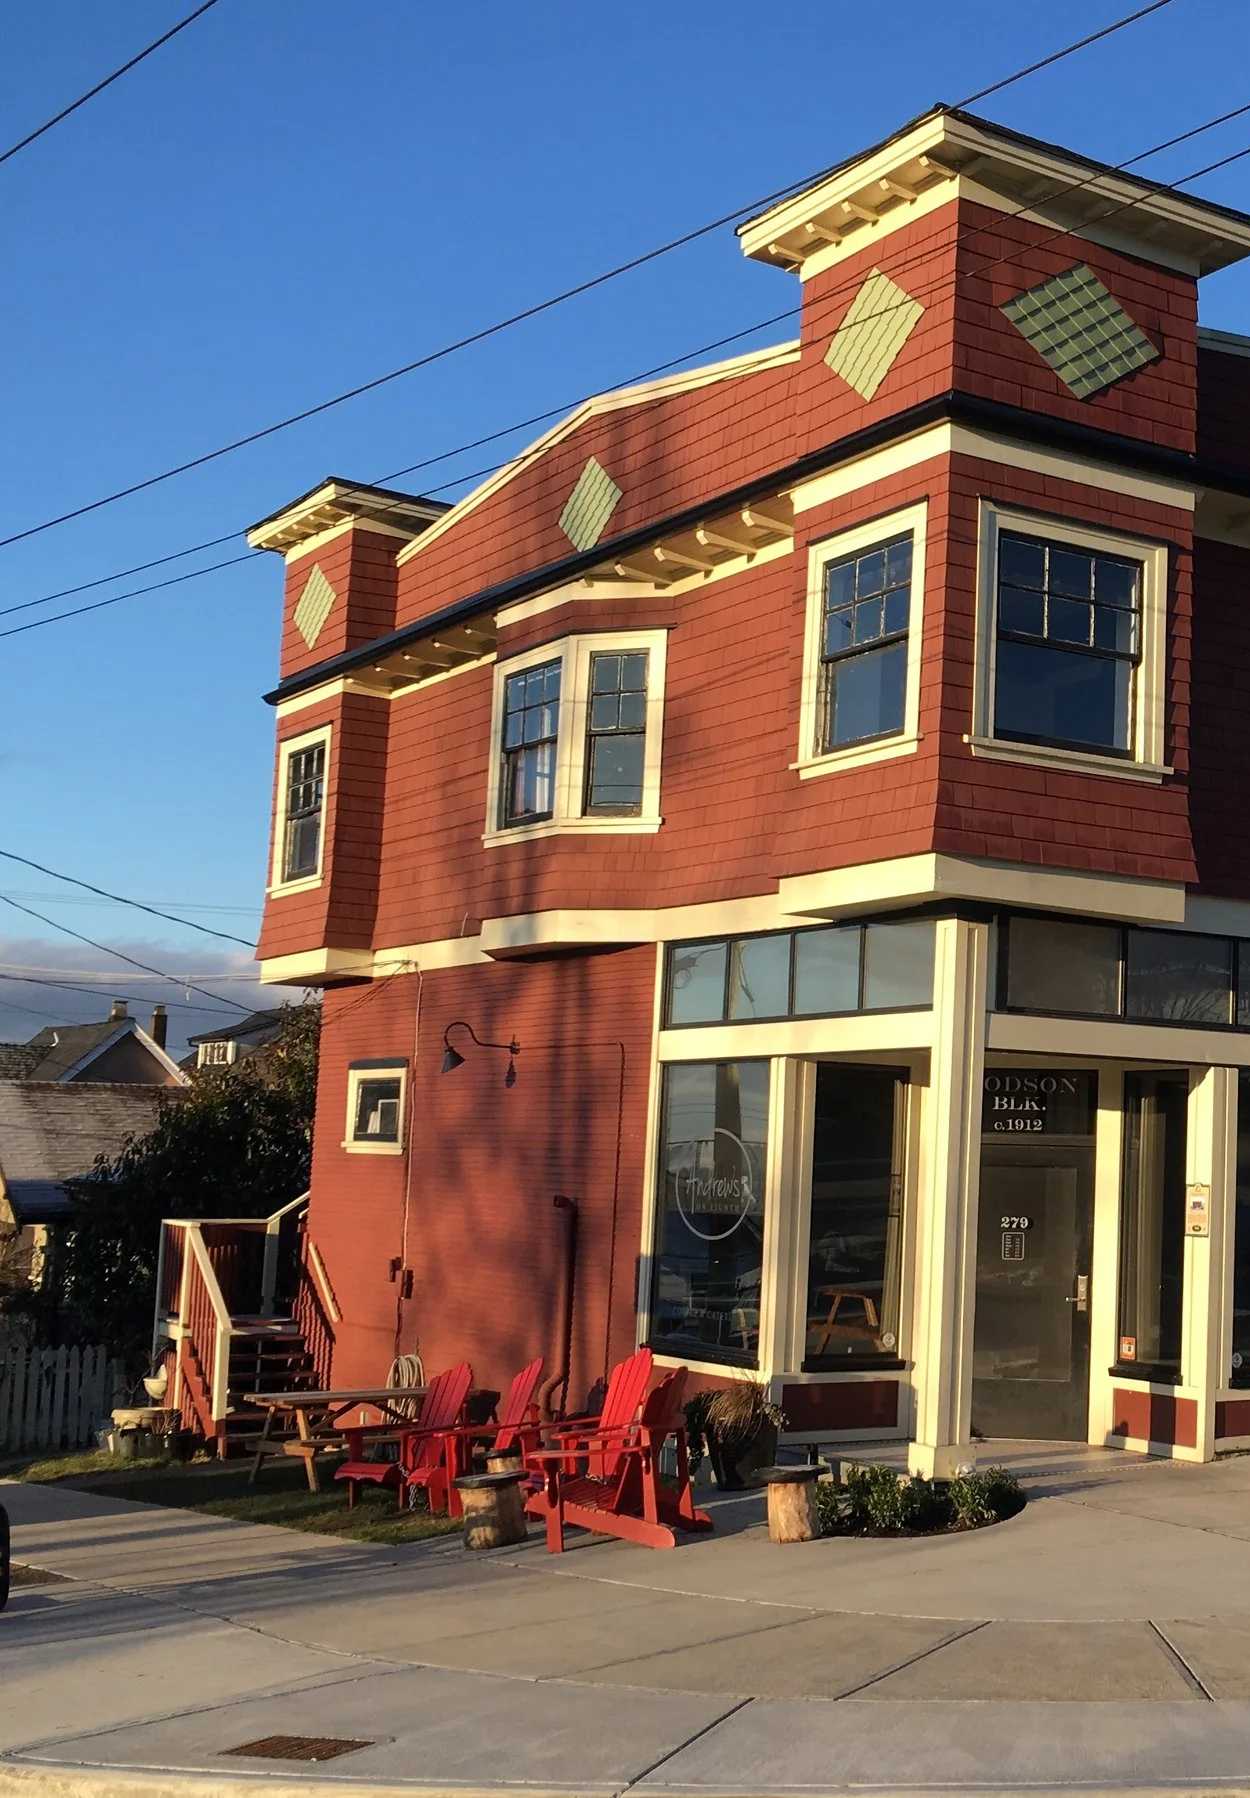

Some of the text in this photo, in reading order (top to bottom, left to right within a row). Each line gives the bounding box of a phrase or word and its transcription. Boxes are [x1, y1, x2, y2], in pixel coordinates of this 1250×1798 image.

[984, 1076, 1078, 1094] ODSON
[992, 1095, 1047, 1111] BLK.
[993, 1118, 1043, 1131] c.1912
[685, 1138, 740, 1214] Andrew's
[1000, 1216, 1029, 1229] 279
